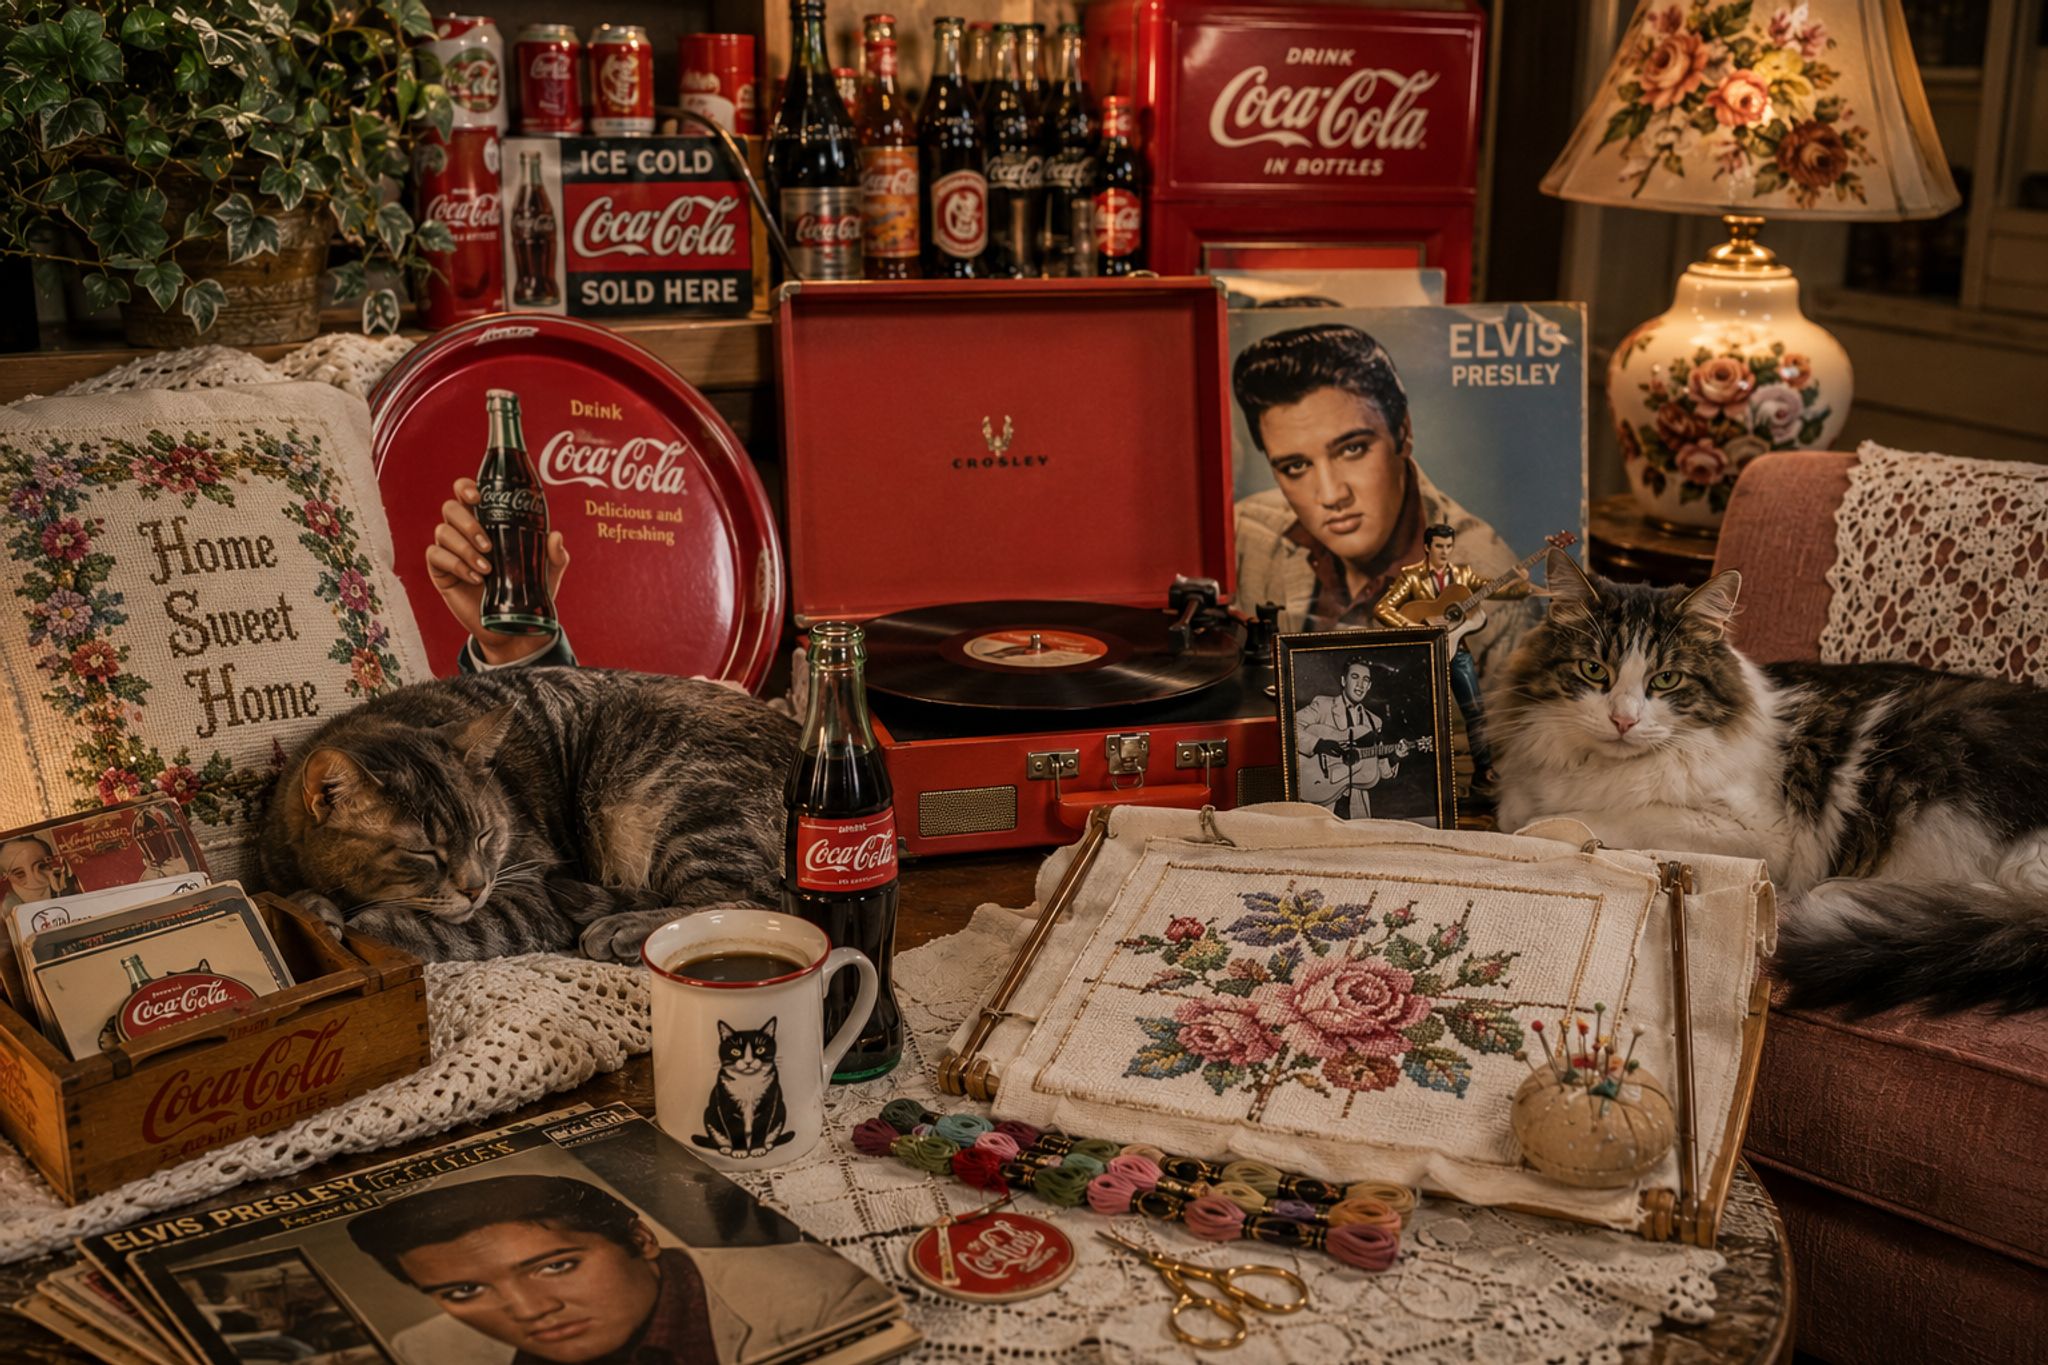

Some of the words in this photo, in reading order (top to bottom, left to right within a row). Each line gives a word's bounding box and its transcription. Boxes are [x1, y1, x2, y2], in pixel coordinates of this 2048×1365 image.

[1286, 48, 1355, 65] DRINK
[1209, 65, 1440, 150] Coca-Cola
[581, 150, 627, 175] ICE
[637, 150, 713, 175] COLD
[1263, 158, 1286, 175] IN
[1294, 158, 1385, 175] BOTTLES
[572, 196, 740, 258] Coca-Cola
[581, 280, 655, 306] SOLD
[664, 279, 739, 304] HERE
[1449, 323, 1563, 358] ELVIS
[1451, 363, 1561, 387] PRESLEY
[538, 430, 690, 496] Coca-Cola
[952, 455, 1048, 470] CROSLEY
[585, 499, 653, 522] Delicious
[656, 507, 684, 524] and
[138, 515, 278, 586] Home
[597, 523, 676, 546] Refreshing
[163, 590, 299, 659] Sweet
[183, 662, 320, 738] Home
[805, 829, 897, 872] Coca-Cola
[132, 980, 228, 1026] Coca-Cola
[142, 1016, 350, 1145] Coca-Cola
[104, 1217, 204, 1251] ELVIS
[208, 1177, 363, 1227] PRESLEY
